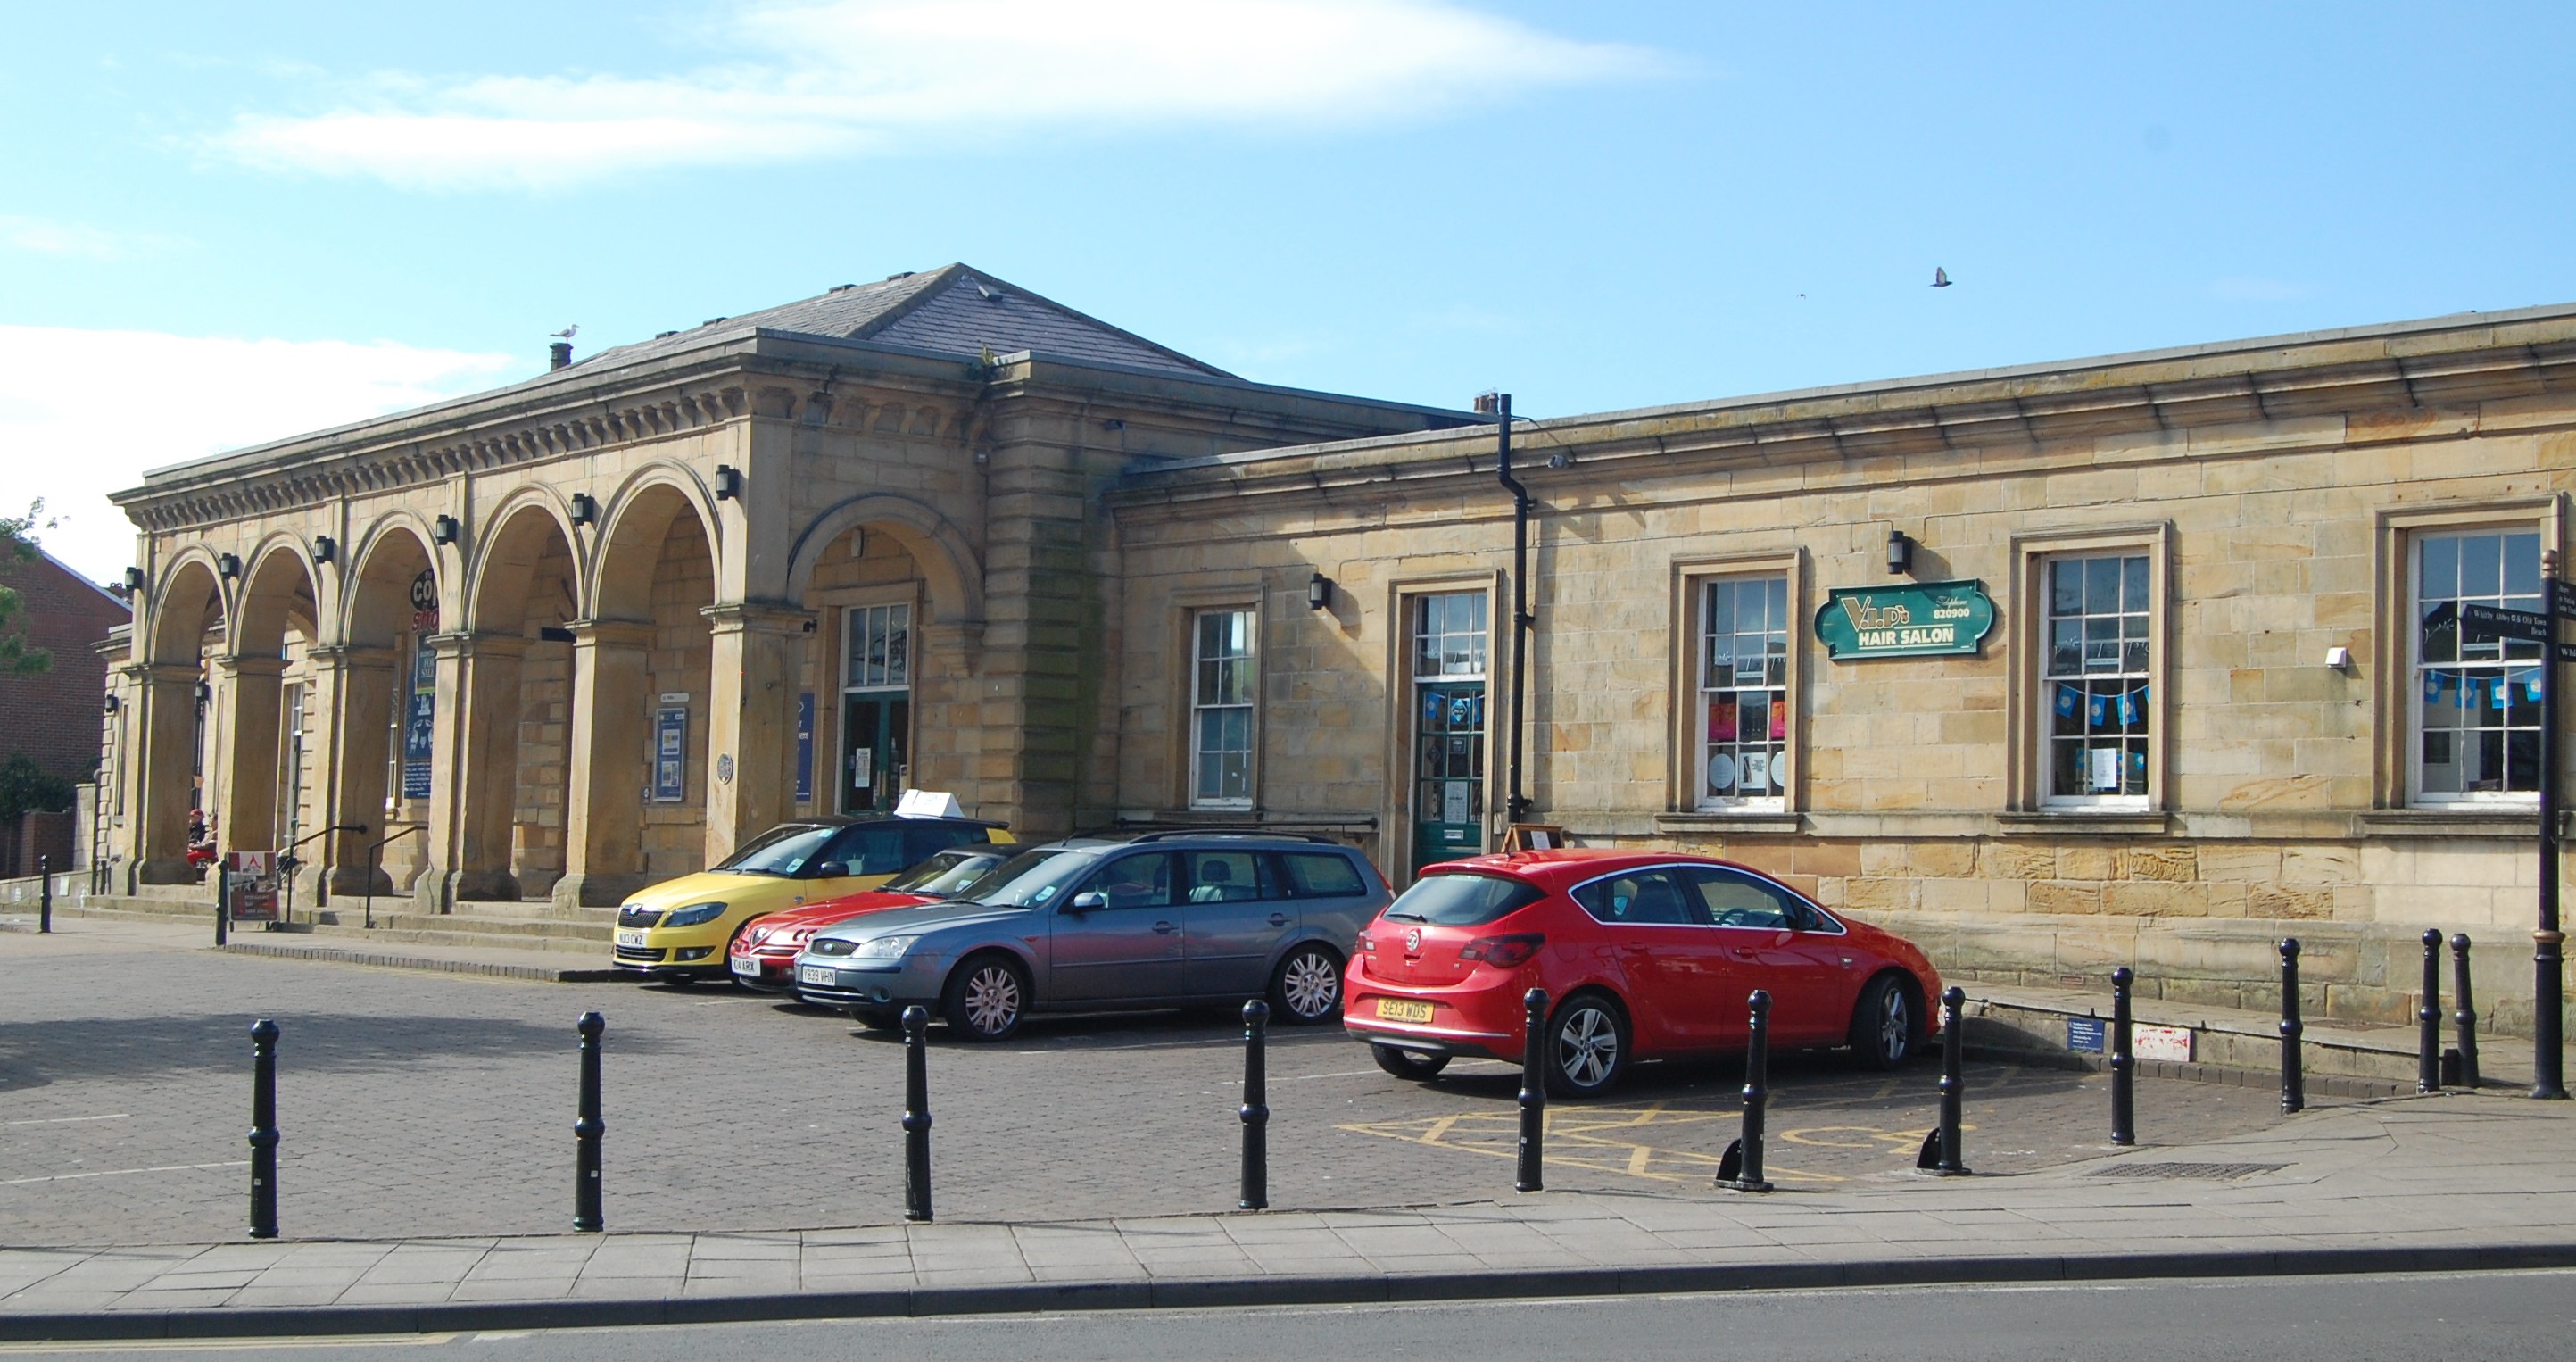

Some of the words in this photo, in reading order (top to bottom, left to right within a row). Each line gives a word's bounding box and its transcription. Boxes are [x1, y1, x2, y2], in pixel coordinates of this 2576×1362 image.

[1934, 608, 1970, 619] 820900
[1859, 631, 1897, 646] HAIR
[1901, 627, 1954, 644] SALON
[821, 969, 834, 983] VHN
[1406, 1003, 1427, 1018] WDS
